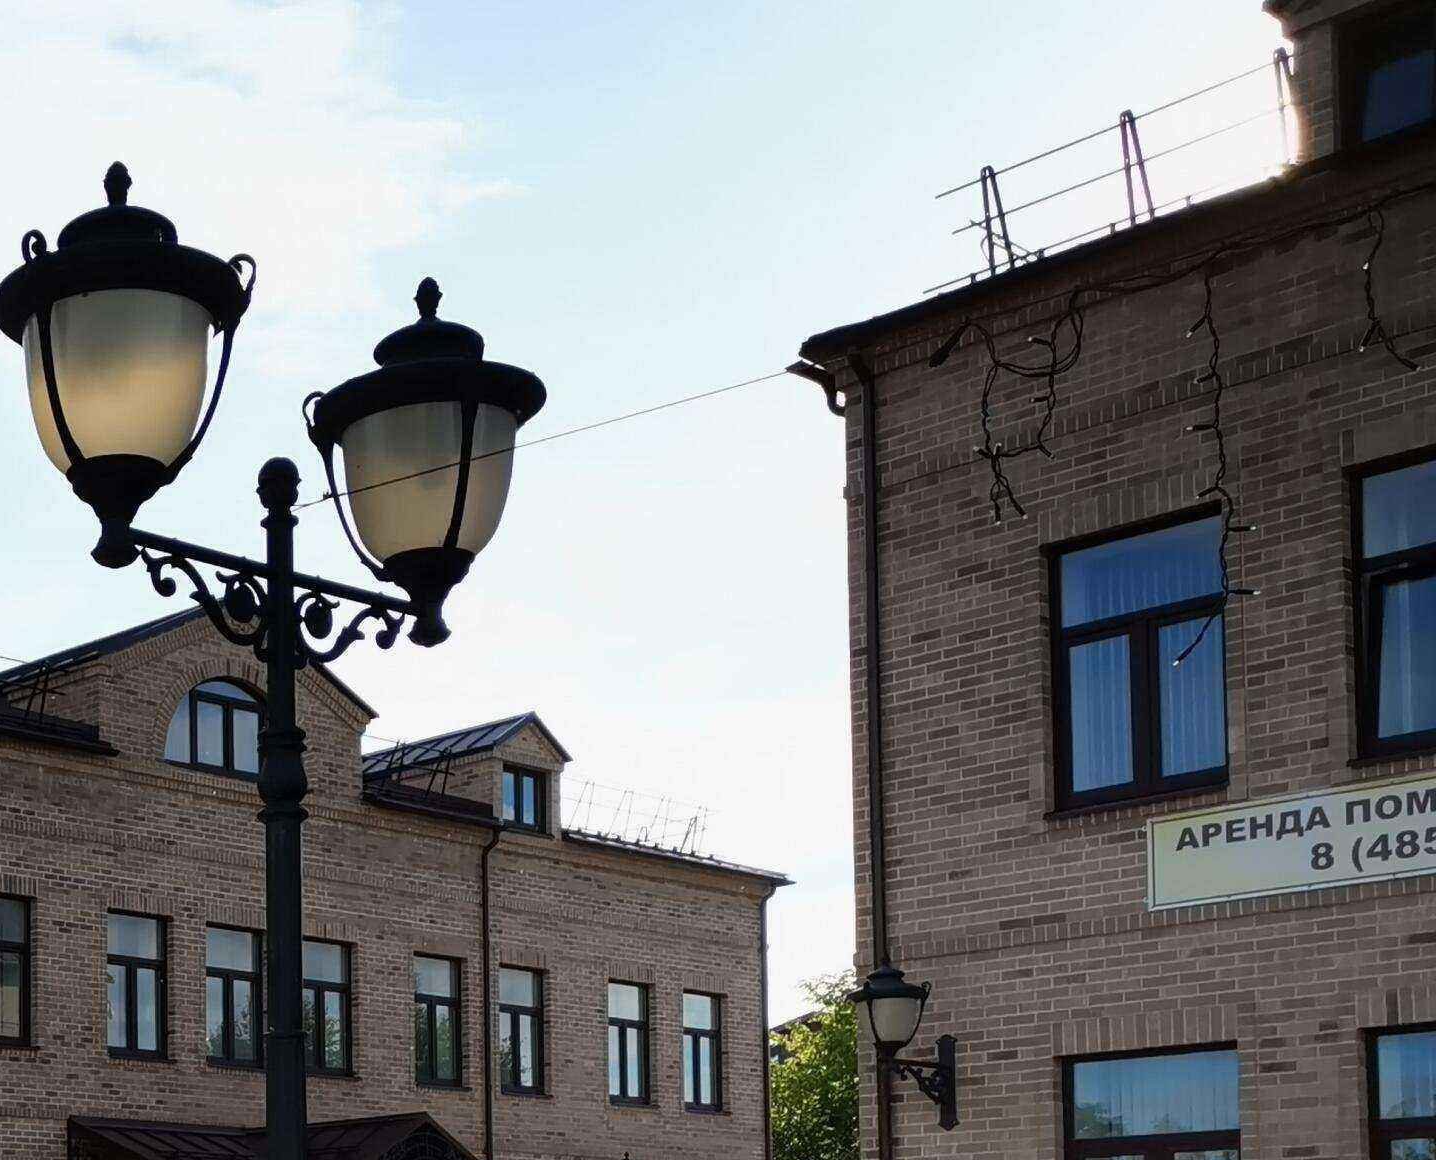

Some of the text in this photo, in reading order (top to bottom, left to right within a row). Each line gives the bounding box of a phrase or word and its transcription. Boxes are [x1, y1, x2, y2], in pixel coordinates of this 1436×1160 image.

[1175, 788, 1436, 851] АРЕНДА ПОМ
[1311, 842, 1335, 870] 8
